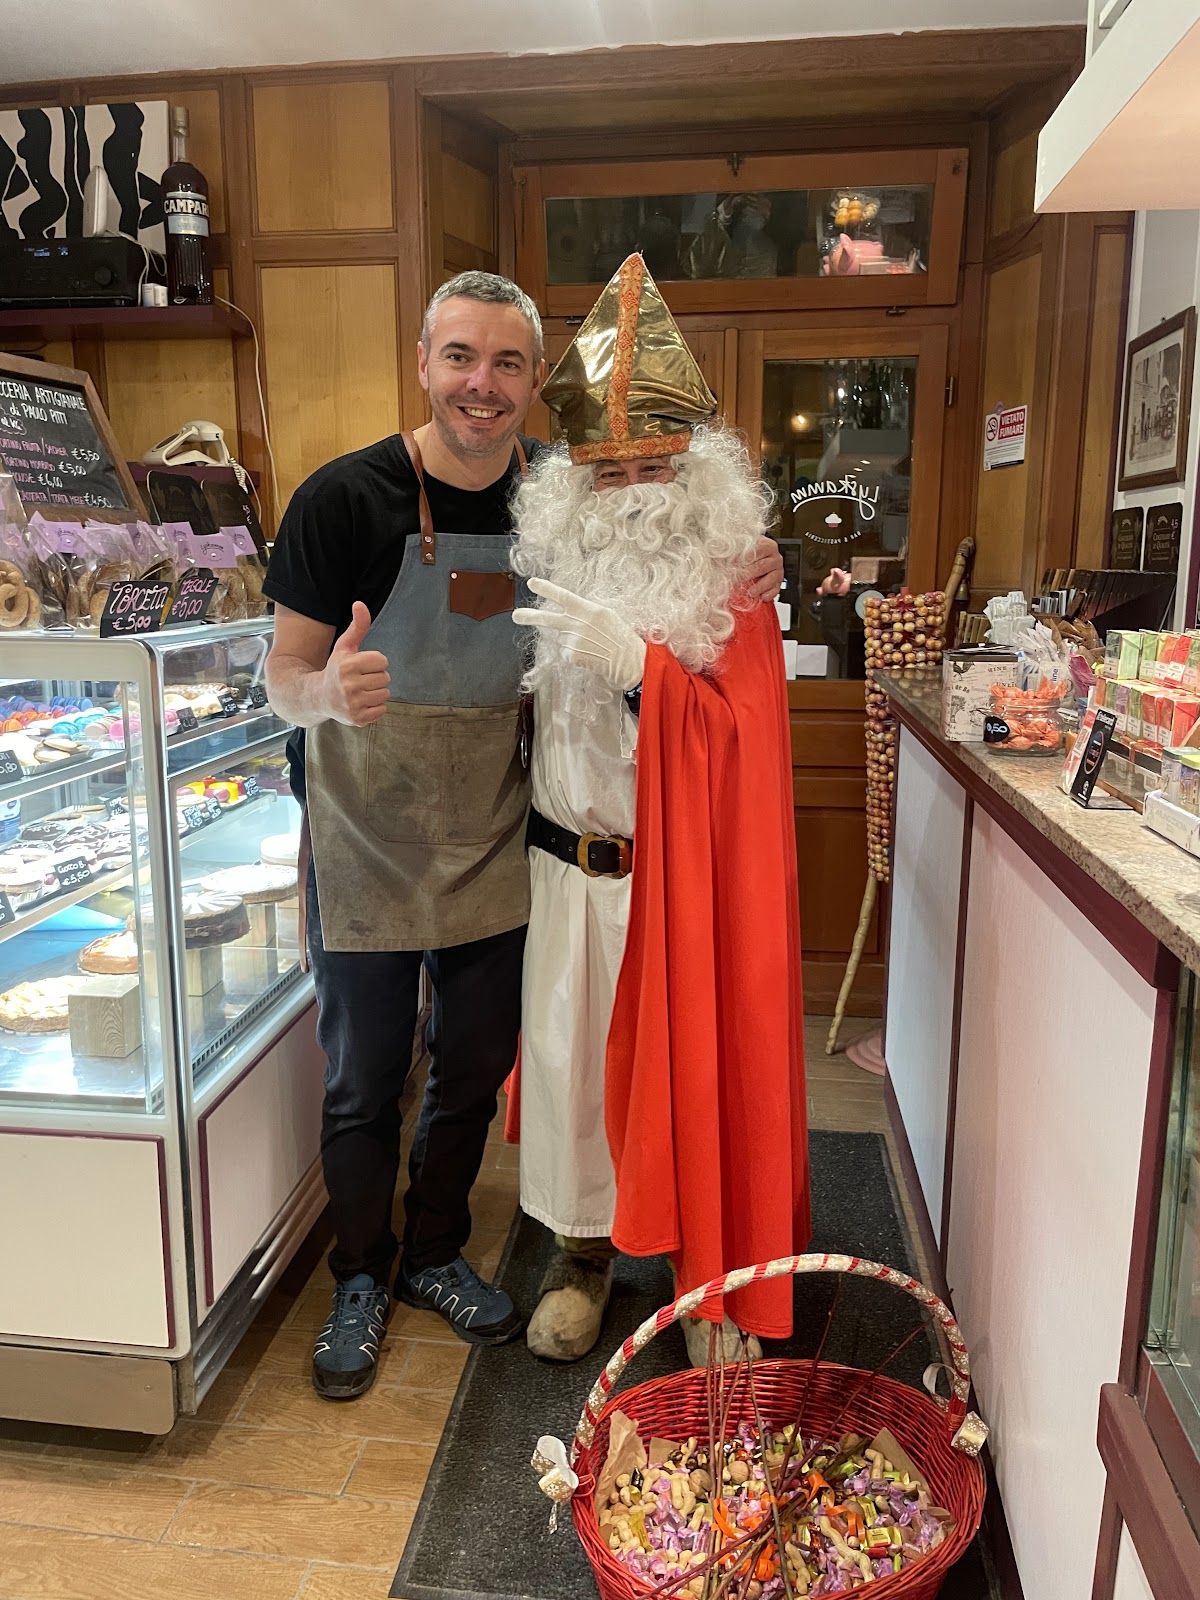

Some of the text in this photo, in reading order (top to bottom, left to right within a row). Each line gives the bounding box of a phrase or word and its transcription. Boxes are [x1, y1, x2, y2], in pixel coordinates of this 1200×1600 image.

[10, 402, 21, 416] di
[1001, 411, 1024, 425] VIETATO
[1000, 424, 1024, 438] FUMARE
[171, 596, 203, 619] €5,00
[986, 722, 1008, 734] 0,50
[62, 869, 91, 886] €5,50
